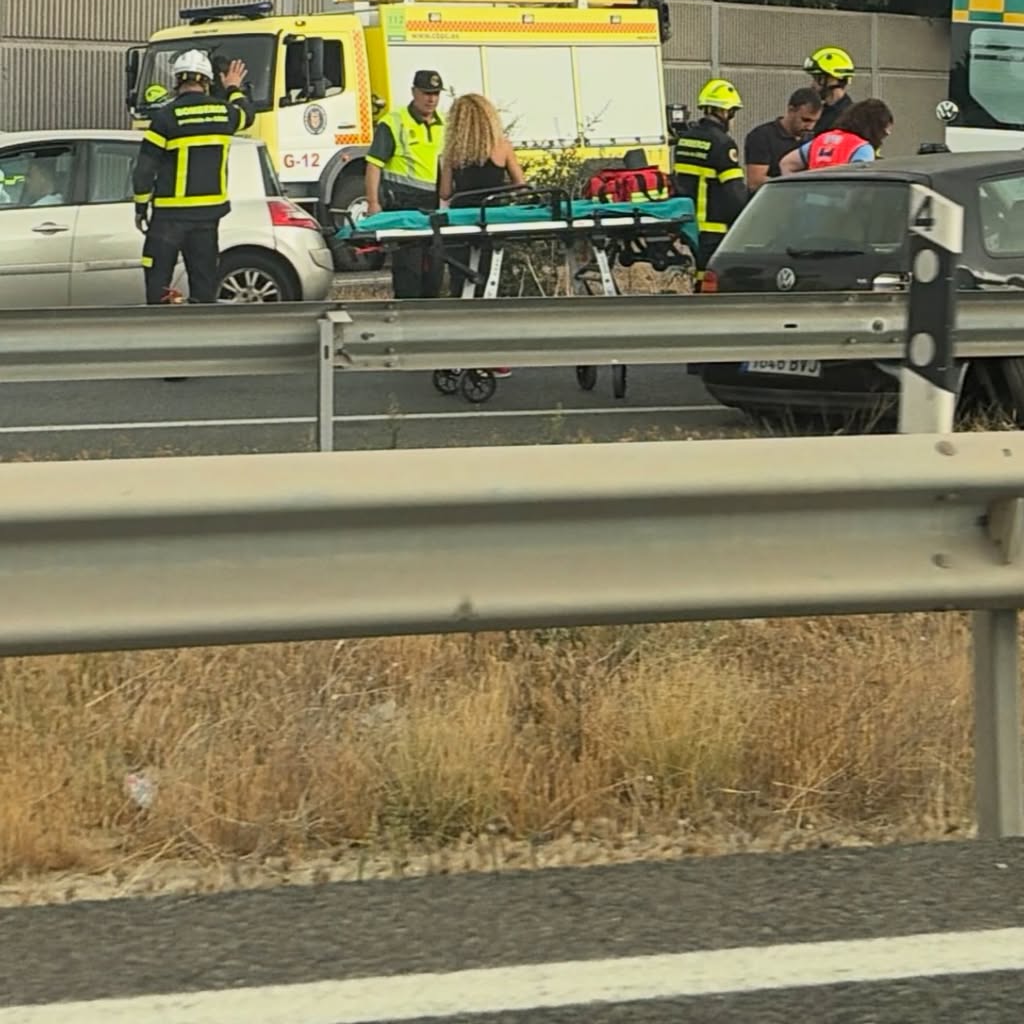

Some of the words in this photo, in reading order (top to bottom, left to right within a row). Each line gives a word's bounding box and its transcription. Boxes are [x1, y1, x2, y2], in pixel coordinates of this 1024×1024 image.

[388, 15, 404, 25] 112
[283, 152, 321, 168] G-12
[914, 195, 935, 232] 4
